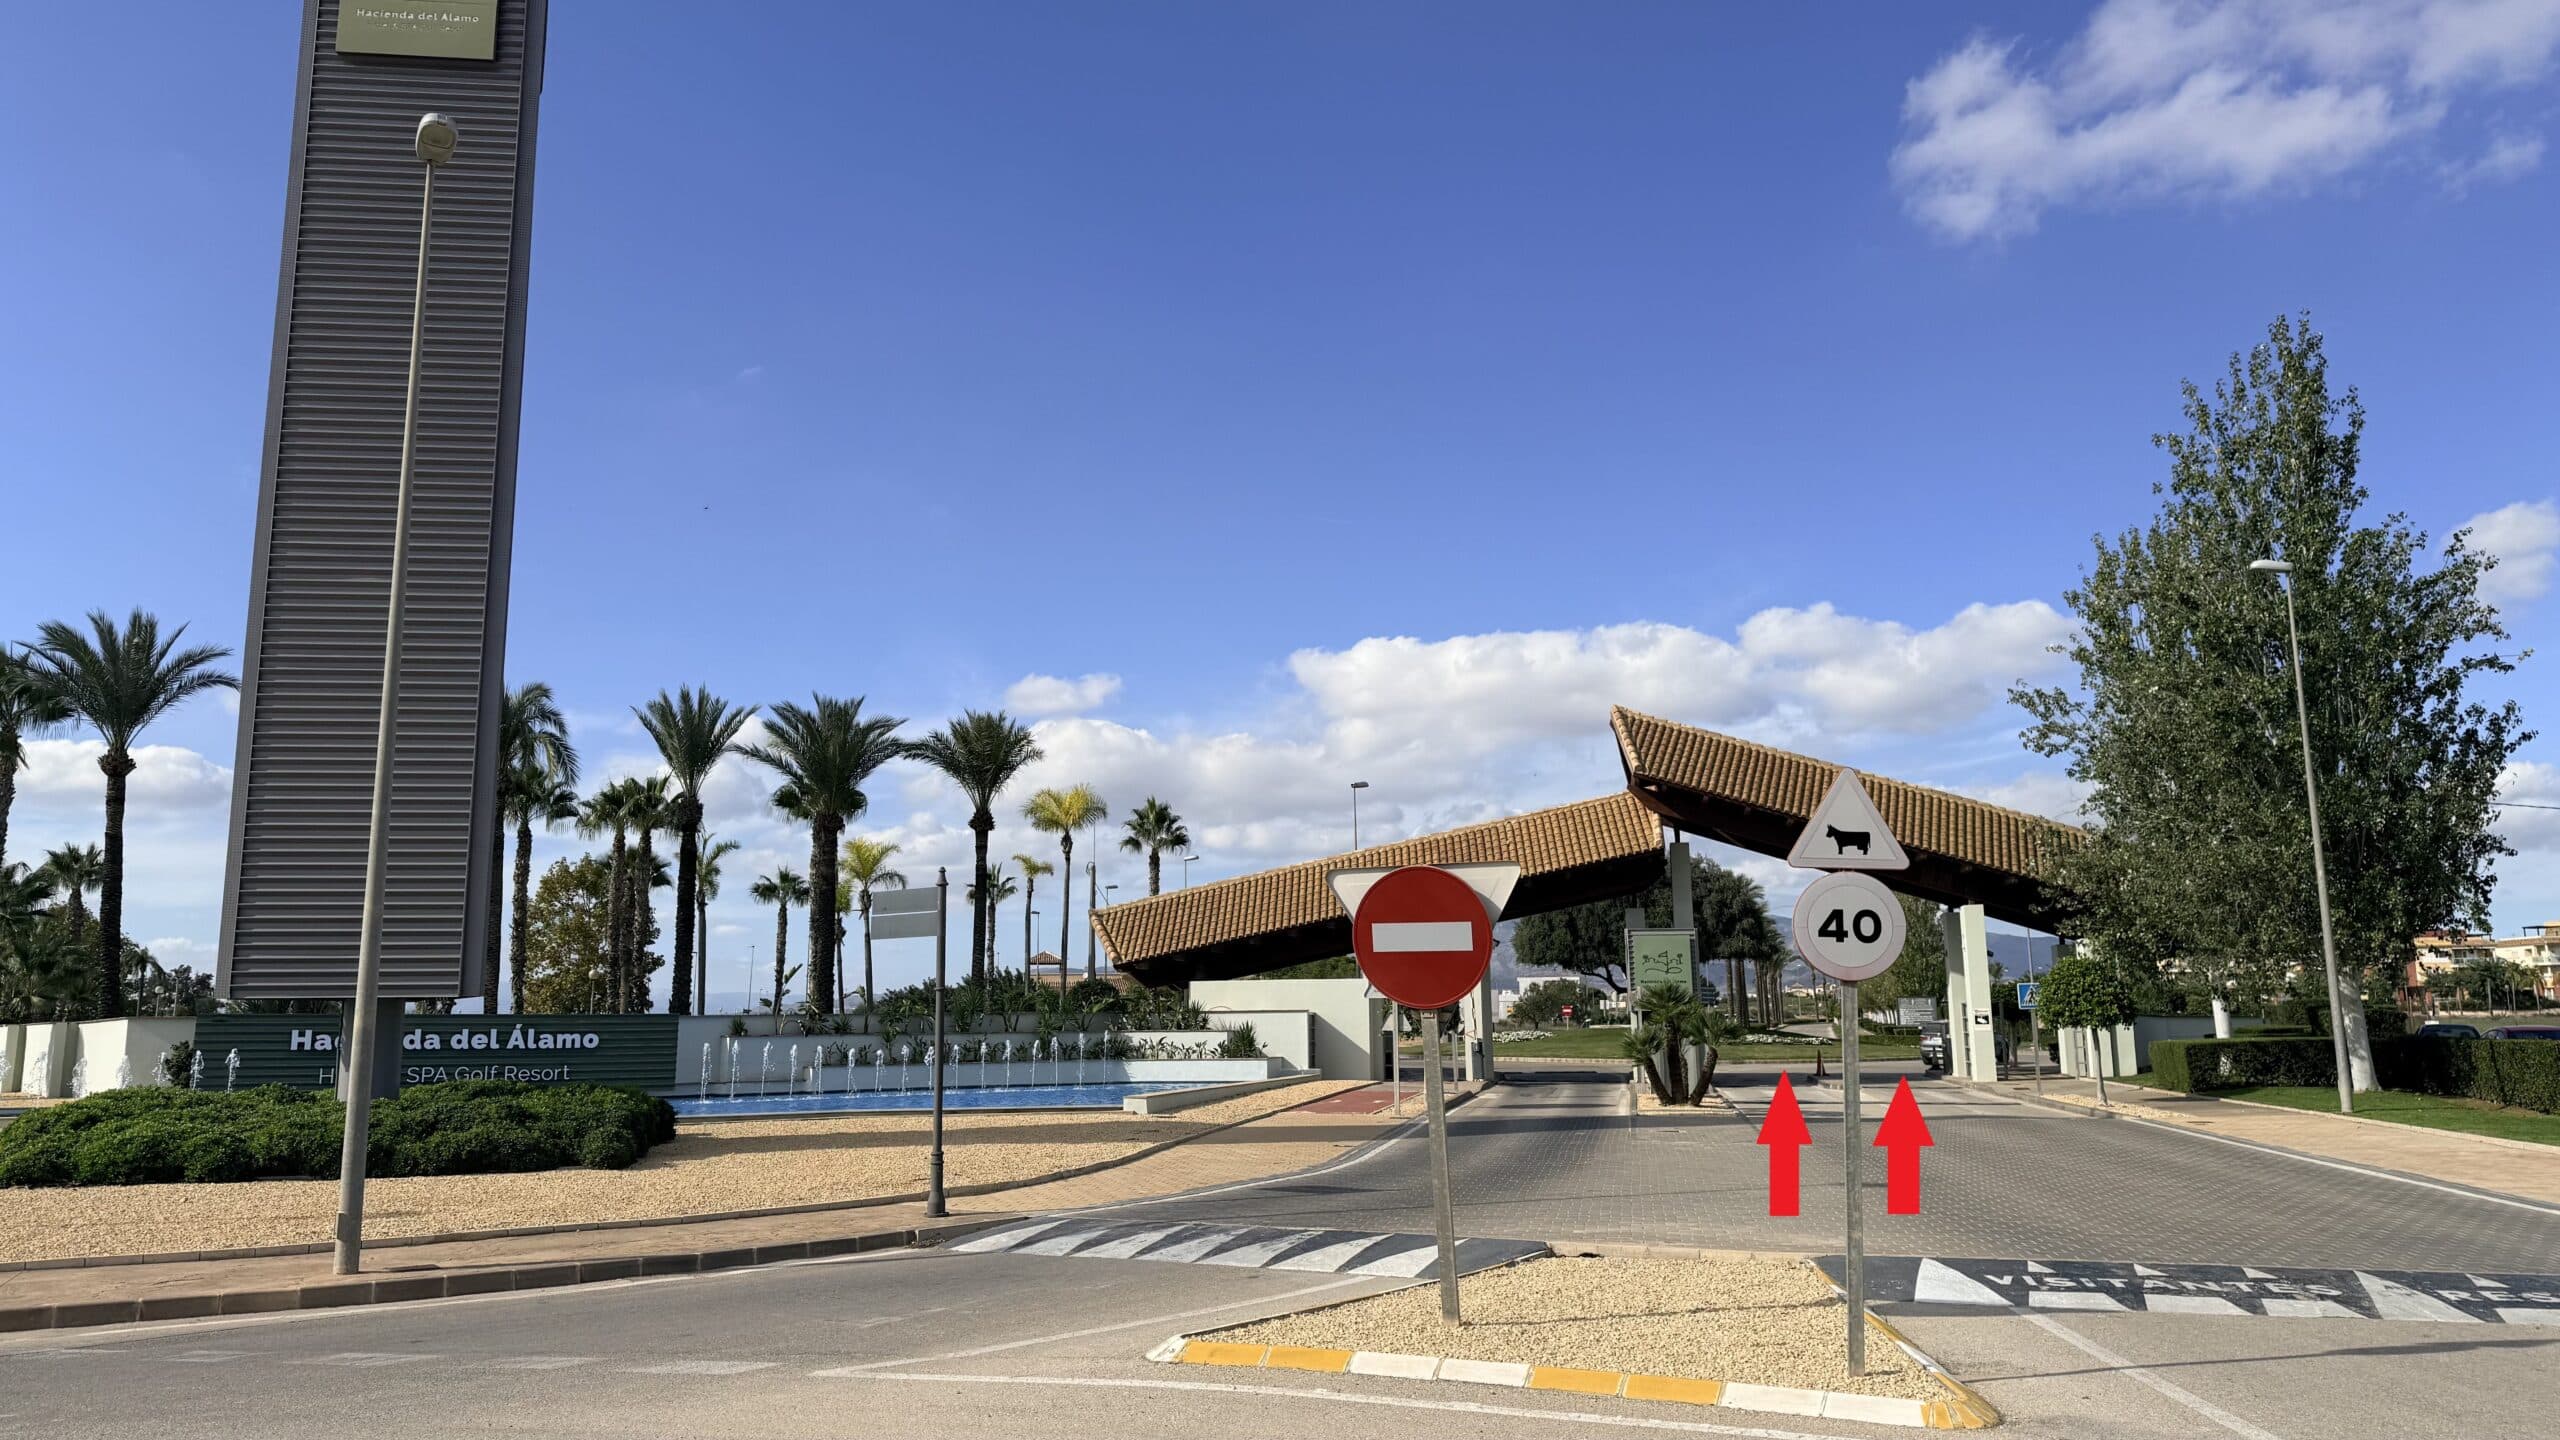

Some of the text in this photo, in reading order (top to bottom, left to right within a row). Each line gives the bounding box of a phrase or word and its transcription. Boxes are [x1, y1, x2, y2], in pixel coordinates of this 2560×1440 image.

[356, 8, 414, 20] Hacienda
[418, 12, 438, 21] del
[1818, 909, 1882, 944] 40
[450, 1028, 500, 1050] del
[506, 1024, 600, 1049] Álamo
[406, 1064, 571, 1083] SPA Golf Resort
[1984, 1274, 2343, 1297] VISITANTES
